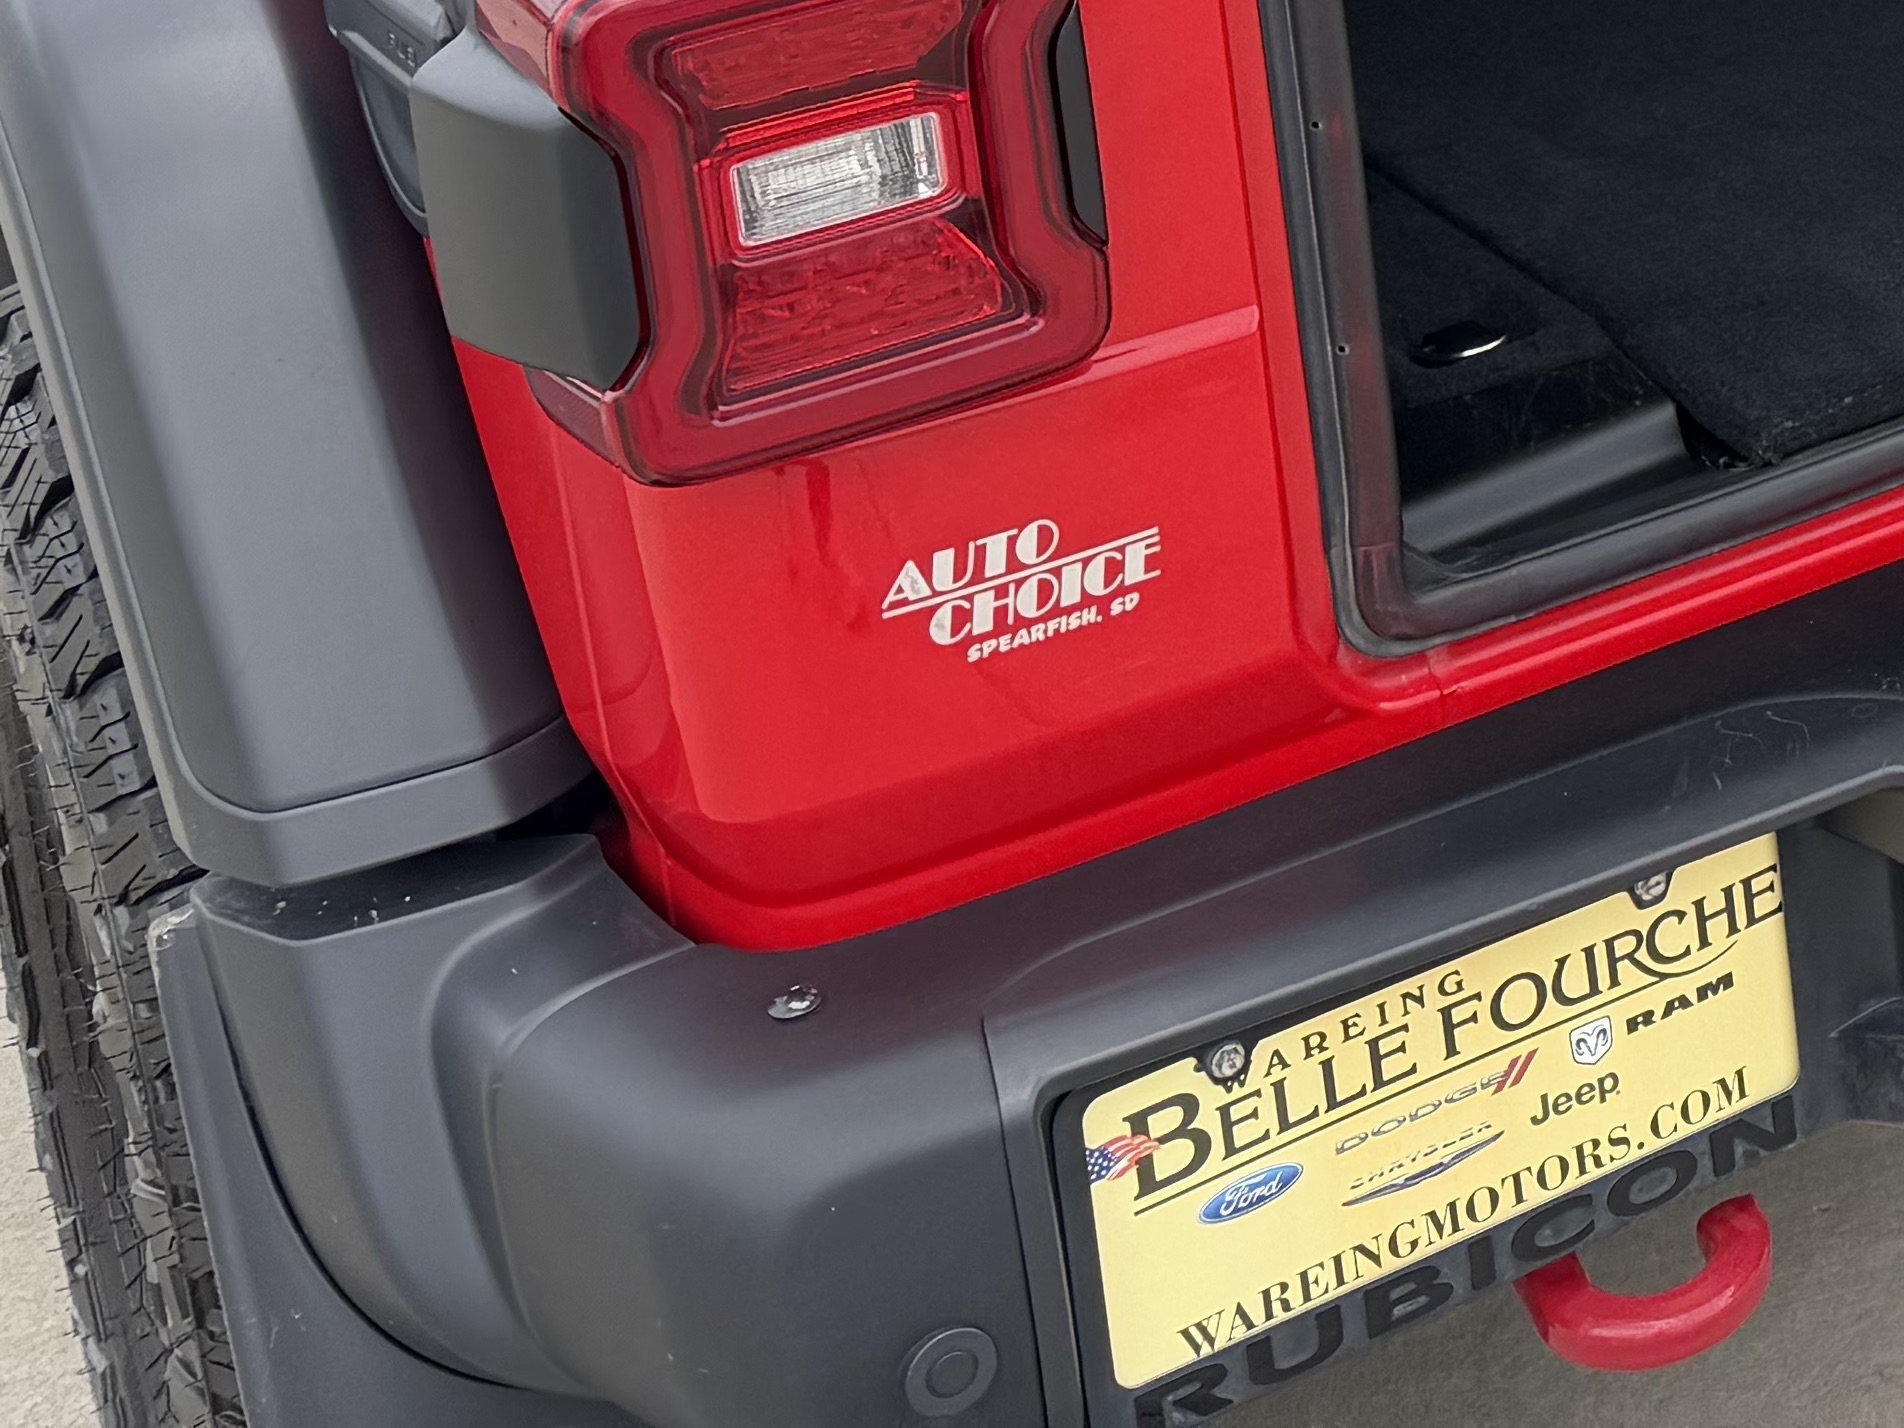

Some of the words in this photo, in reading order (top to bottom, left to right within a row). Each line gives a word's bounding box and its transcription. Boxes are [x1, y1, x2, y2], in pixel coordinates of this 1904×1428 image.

[881, 518, 1061, 610] AUTO
[929, 534, 1162, 646] CHOICE
[1109, 591, 1141, 617] SD
[1123, 1023, 1417, 1202] BELLE
[1437, 863, 1784, 1061] FOURCHE
[1626, 971, 1735, 1036] RAM
[1335, 1067, 1515, 1156] DODGE
[1530, 1070, 1621, 1127] Jeep
[1177, 1065, 1751, 1360] WAREINGMOTORS.COM
[1219, 1175, 1284, 1220] Ford
[1134, 1092, 1800, 1428] RUBICON
